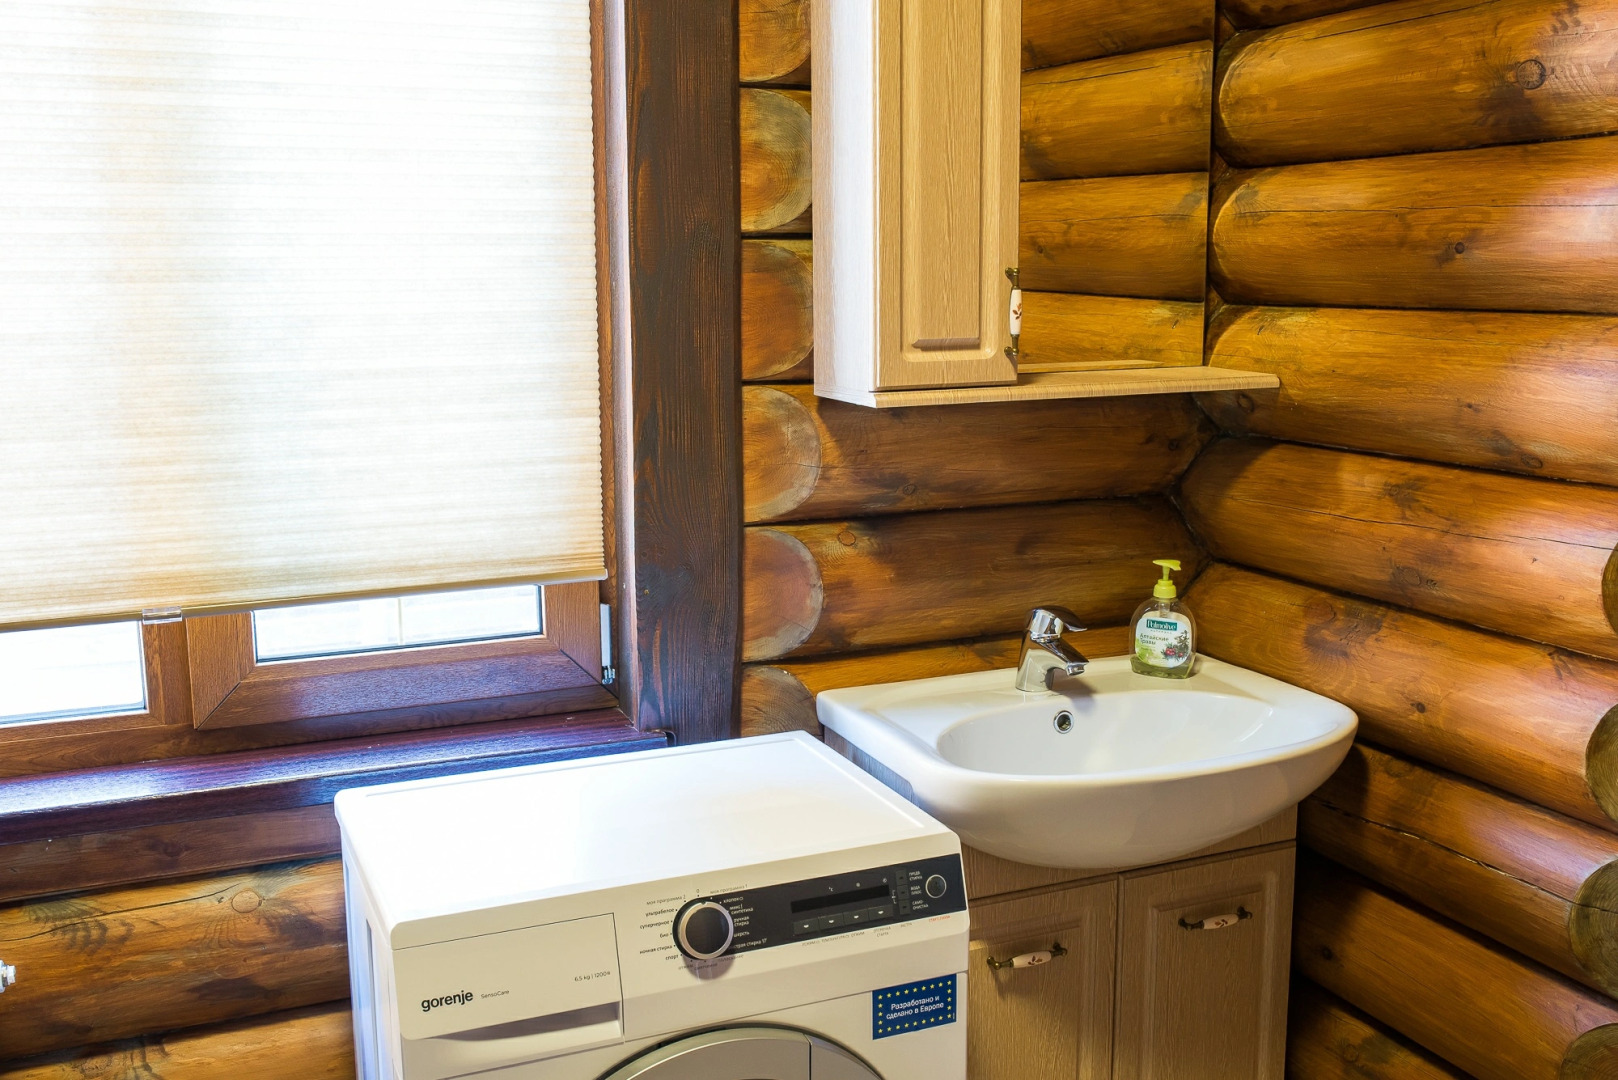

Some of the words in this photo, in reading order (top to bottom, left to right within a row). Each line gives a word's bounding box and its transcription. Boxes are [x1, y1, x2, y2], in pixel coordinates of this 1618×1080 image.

[645, 908, 674, 917] ультрабелое
[421, 990, 473, 1012] gorenje
[481, 990, 510, 999] SensoCare
[890, 996, 934, 1010] Разработано
[886, 1010, 913, 1020] сделано
[920, 1002, 944, 1012] Европе
